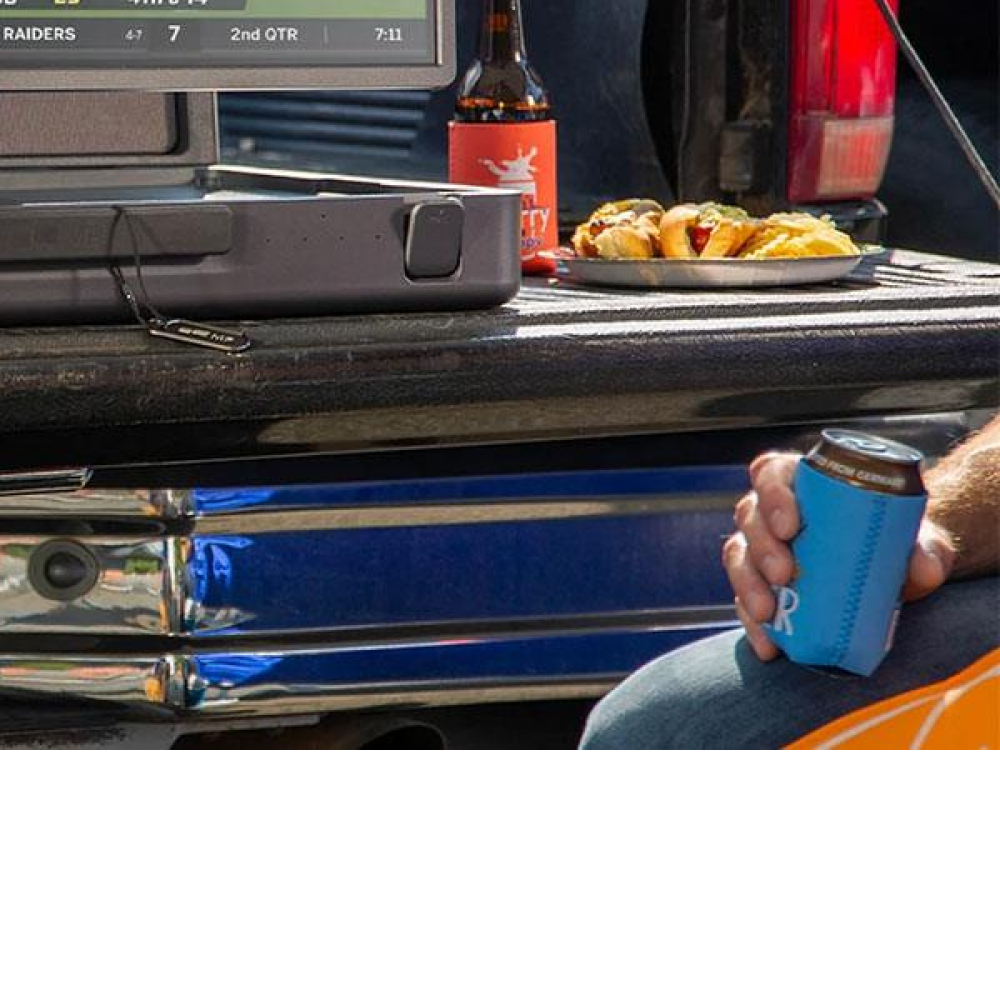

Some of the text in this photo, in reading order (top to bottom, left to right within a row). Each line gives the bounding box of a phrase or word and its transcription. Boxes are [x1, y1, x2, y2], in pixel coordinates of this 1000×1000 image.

[3, 26, 76, 42] RAIDERS
[168, 24, 181, 43] 7
[230, 27, 261, 41] 2nd
[264, 27, 299, 42] QTR
[374, 27, 403, 41] 7:11
